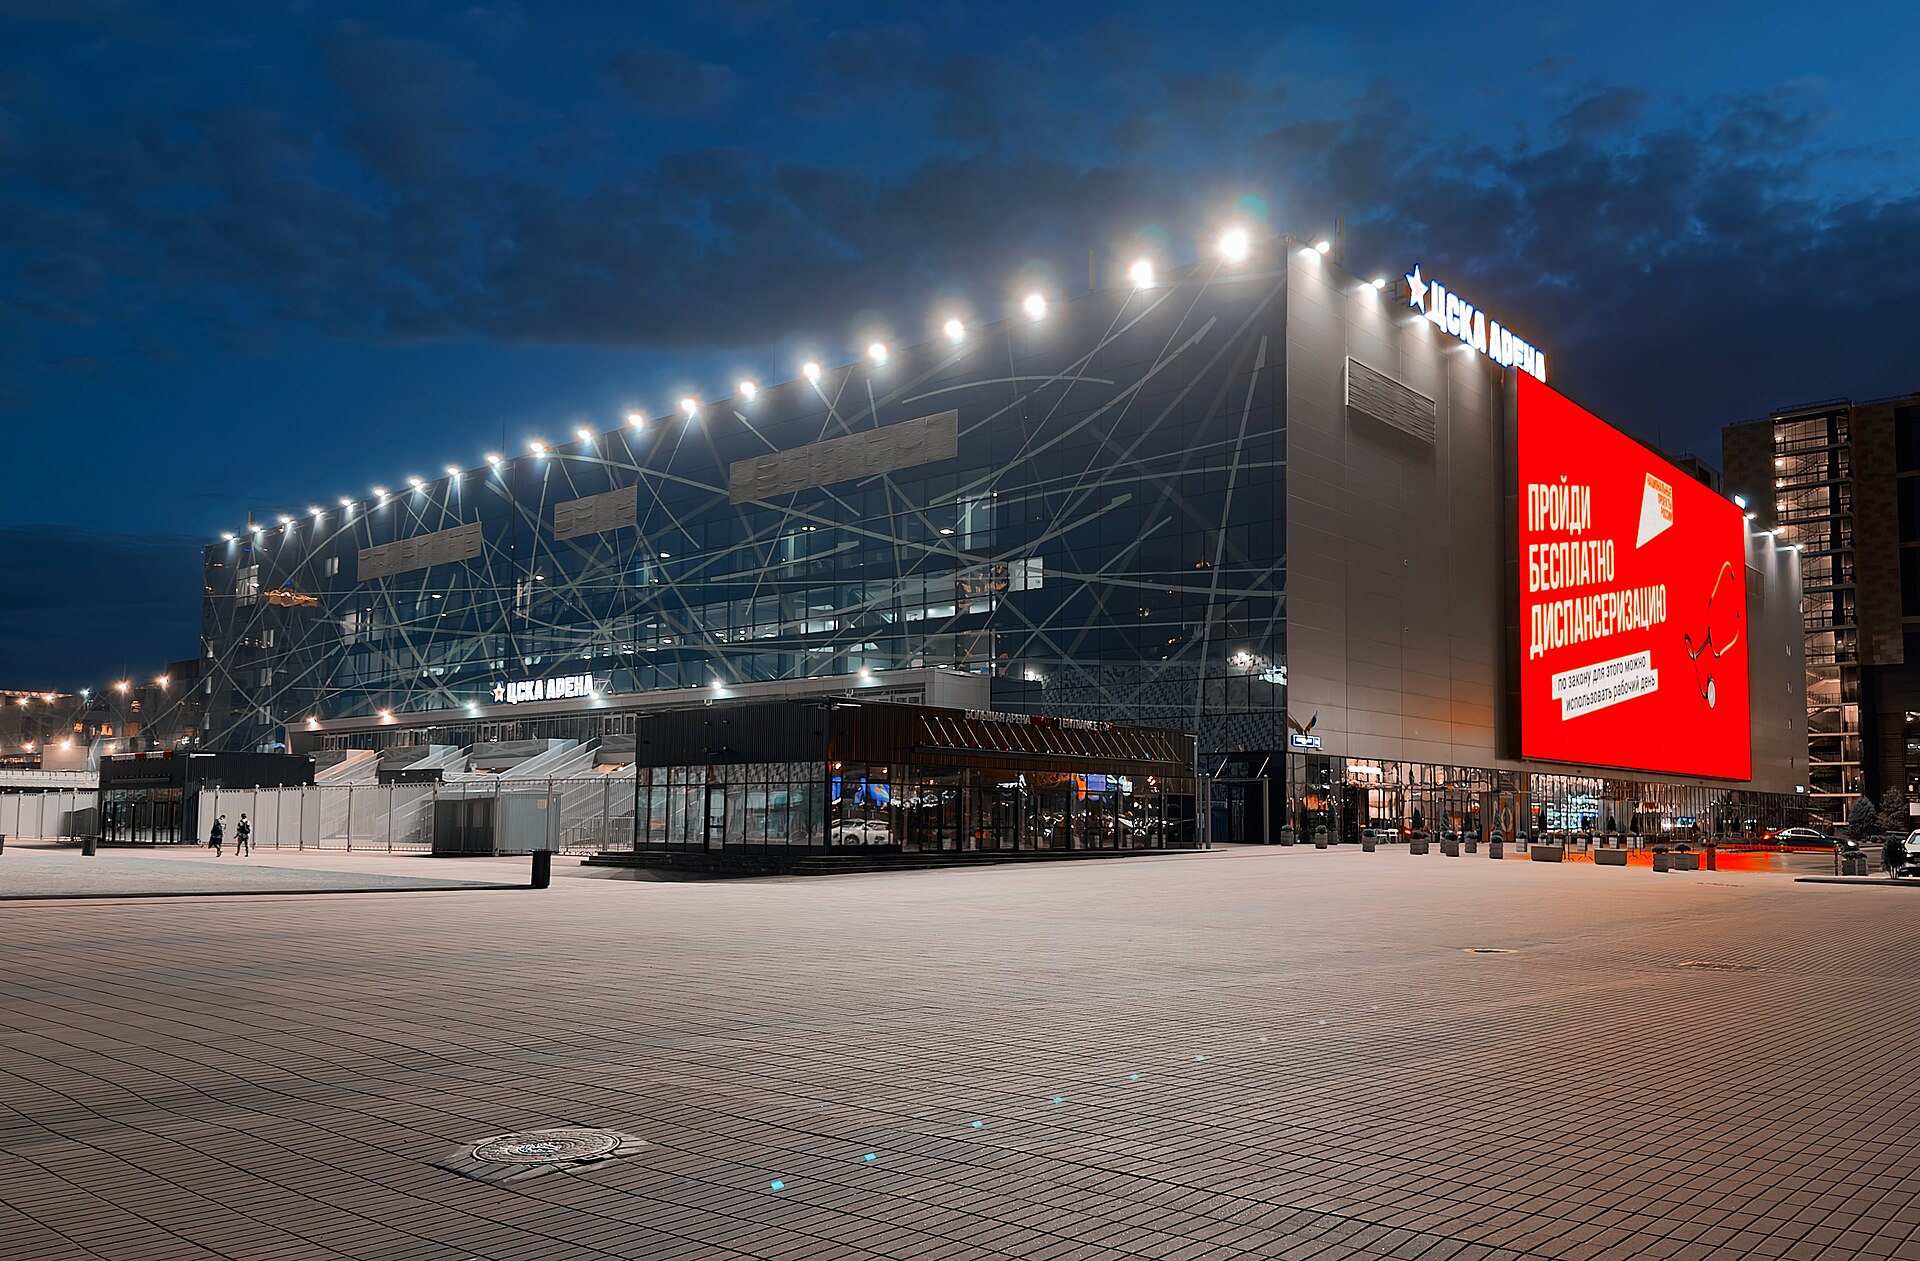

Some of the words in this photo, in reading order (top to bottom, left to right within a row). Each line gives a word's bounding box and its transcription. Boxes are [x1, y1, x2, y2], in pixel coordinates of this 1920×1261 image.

[1430, 279, 1487, 354] ЦСКА
[1488, 320, 1546, 383] АРЕНА
[1528, 475, 1591, 535] ПРОЙДИ
[1529, 539, 1615, 593] БЕСПЛАТНО
[1529, 584, 1667, 660] ДИСПАНСЕРИЗАЦИЮ
[506, 679, 544, 705] ЦСКА
[546, 674, 594, 699] АРЕНА
[1557, 678, 1567, 691] по
[1568, 671, 1592, 688] закону
[1592, 667, 1605, 685] для
[1606, 662, 1624, 678] этого
[1624, 656, 1646, 672] можно
[1566, 687, 1613, 712] использовать
[1613, 675, 1640, 702] рабочий
[1640, 675, 1655, 693] день
[1005, 712, 1031, 725] АРЕНА
